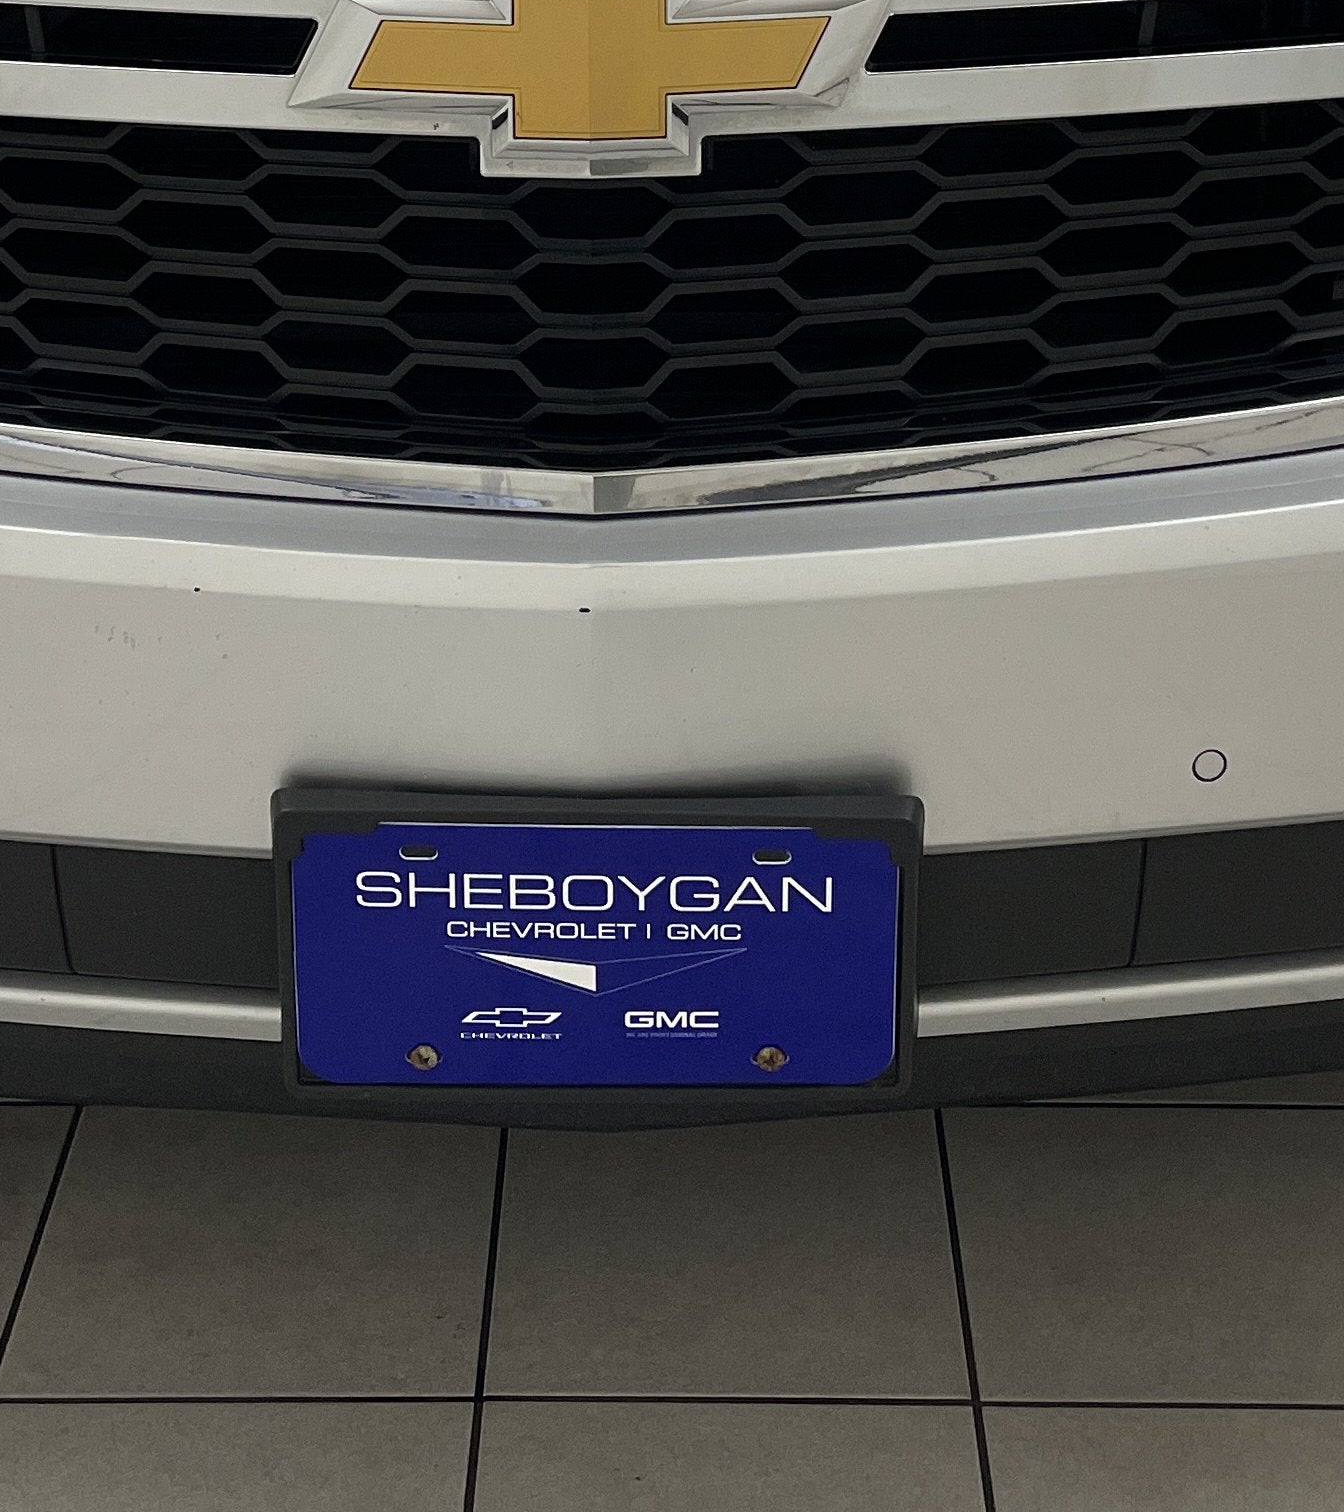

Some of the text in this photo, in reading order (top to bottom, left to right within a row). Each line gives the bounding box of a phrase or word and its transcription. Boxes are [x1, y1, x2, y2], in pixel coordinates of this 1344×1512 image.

[355, 871, 834, 913] SHEBOYGAN
[446, 920, 637, 940] CHEVROLET
[666, 923, 742, 941] GMC
[624, 1010, 720, 1029] GMC
[460, 1031, 564, 1040] CHEVROLET
